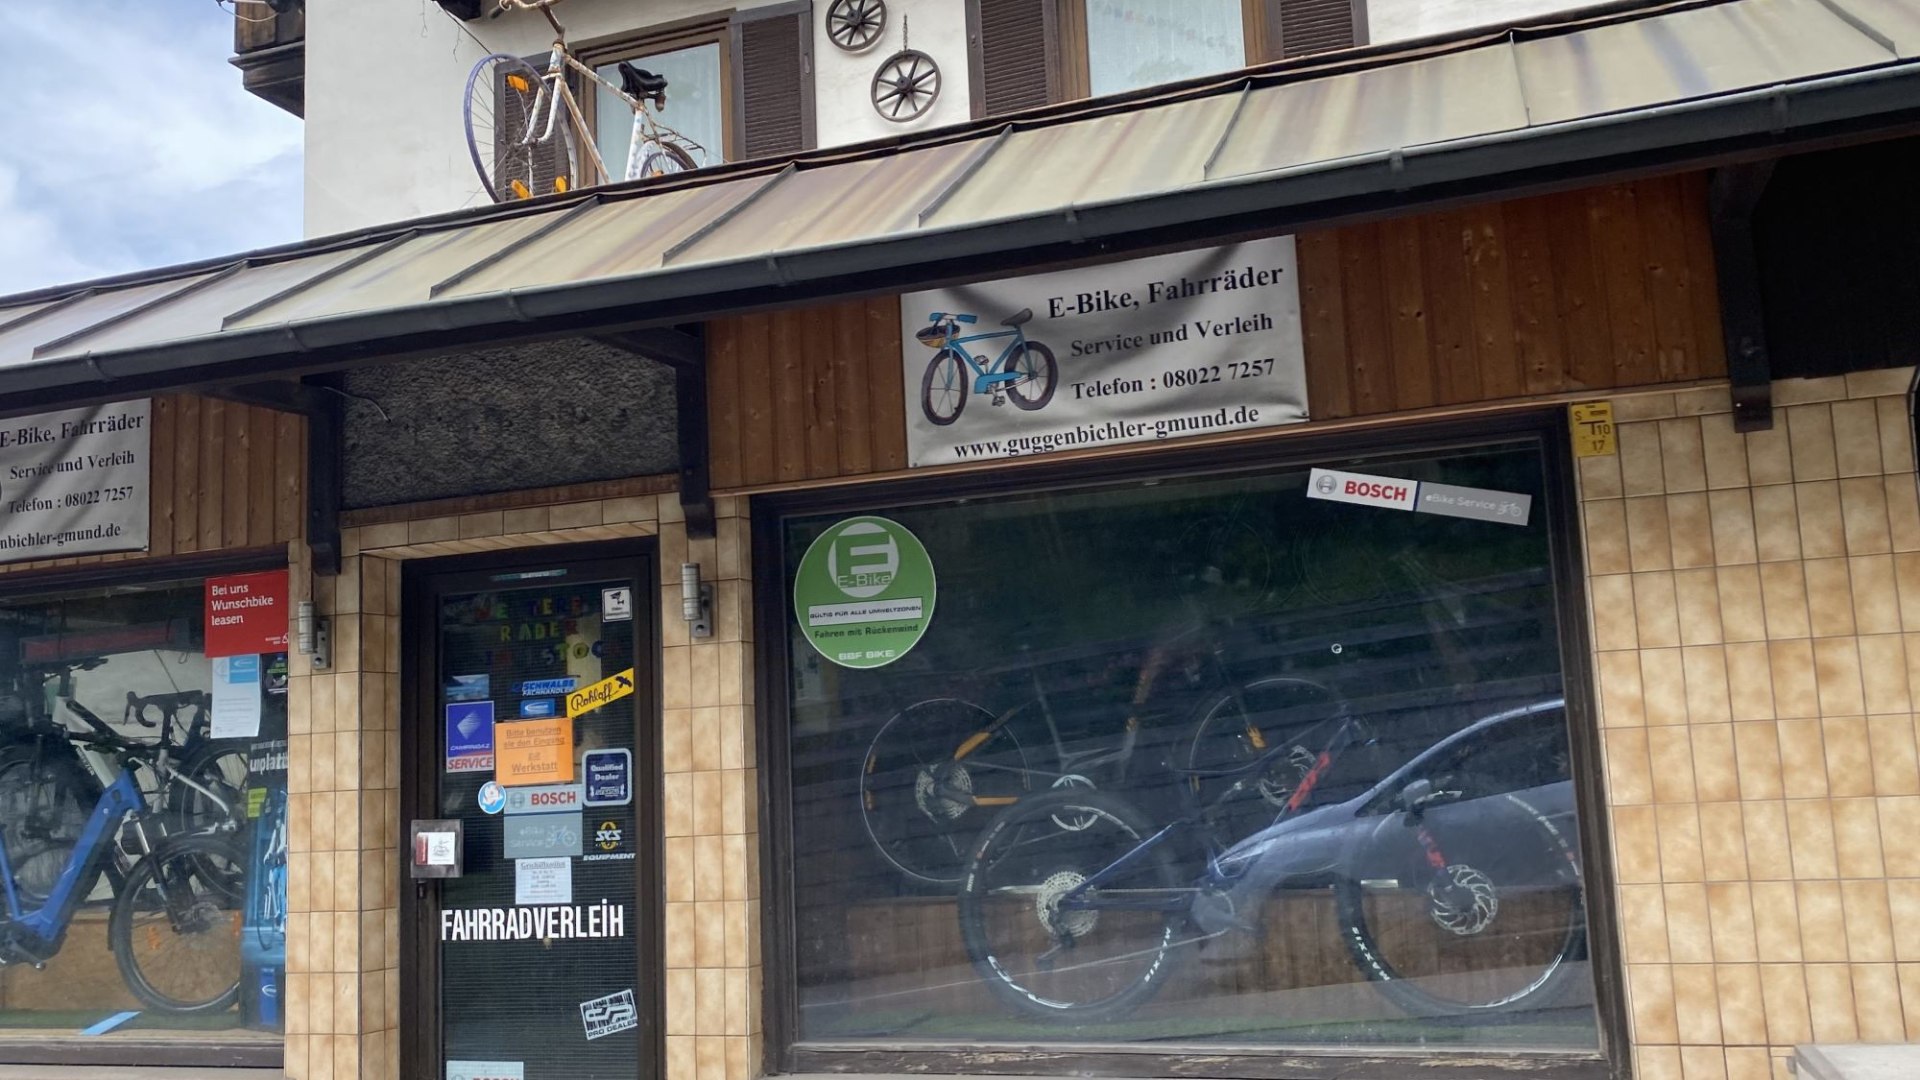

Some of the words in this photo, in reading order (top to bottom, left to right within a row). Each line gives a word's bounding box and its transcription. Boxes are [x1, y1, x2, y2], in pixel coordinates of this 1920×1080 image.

[1048, 291, 1140, 320] E-Bike,
[1148, 265, 1284, 304] Fahrräder
[1071, 332, 1144, 358] Service
[1149, 323, 1188, 346] und
[1194, 313, 1274, 341] Verleih
[1071, 376, 1144, 401] Telefon
[1162, 365, 1222, 390] 08022
[1227, 357, 1275, 381] 7257
[0, 426, 56, 448] E-Bike,
[61, 413, 144, 439] Fahrräder
[953, 406, 1260, 460] www.guggenbichler-gmund.de
[10, 462, 55, 480] Service
[56, 456, 83, 473] und
[87, 450, 135, 469] Verleih
[1344, 480, 1408, 502] BOSCH
[8, 497, 53, 514] Telefon
[64, 490, 100, 508] 08022
[104, 486, 134, 502] 7257
[1457, 496, 1497, 511] Service
[838, 573, 891, 588] E-Bike
[211, 584, 228, 597] Bei
[230, 584, 249, 594] uns
[211, 596, 274, 611] Wunschbike
[810, 611, 833, 619] GÜLTIG
[834, 609, 849, 617] FÜR
[868, 605, 922, 615] UMWELTZONEN
[211, 615, 244, 626] leasen
[814, 629, 845, 639] Fahren
[847, 628, 863, 637] mit
[865, 623, 919, 636] Rückenwind
[866, 649, 896, 660] BIKE
[570, 682, 614, 712] Rohloff
[448, 756, 493, 770] SERVICE
[590, 763, 624, 773] Qualified
[594, 773, 620, 781] Dealer
[531, 791, 577, 805] BOSCH
[595, 829, 622, 841] SKS
[583, 853, 637, 861] EQUIPMENT
